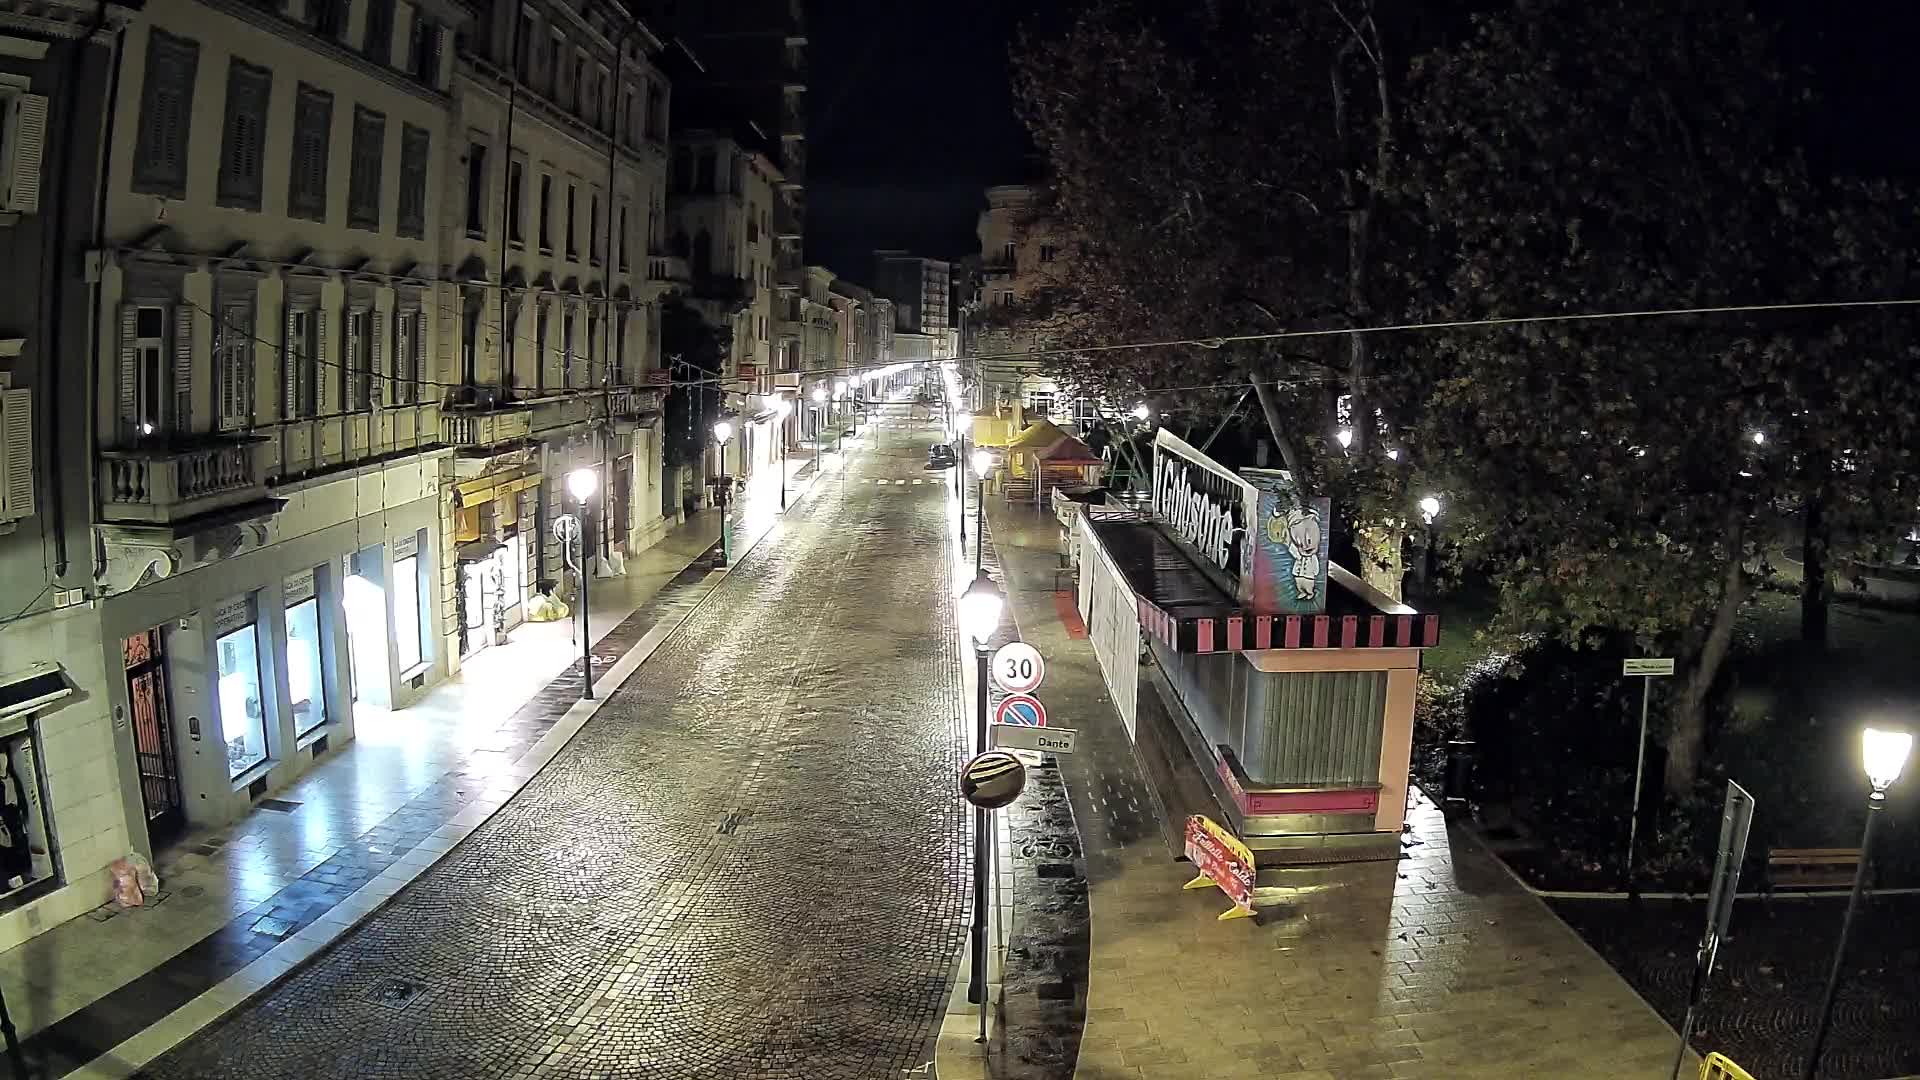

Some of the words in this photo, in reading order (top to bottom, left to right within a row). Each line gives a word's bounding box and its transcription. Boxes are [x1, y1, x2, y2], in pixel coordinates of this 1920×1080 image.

[1162, 459, 1233, 570] Golosone
[1006, 658, 1032, 679] 30
[1038, 737, 1069, 749] Dante
